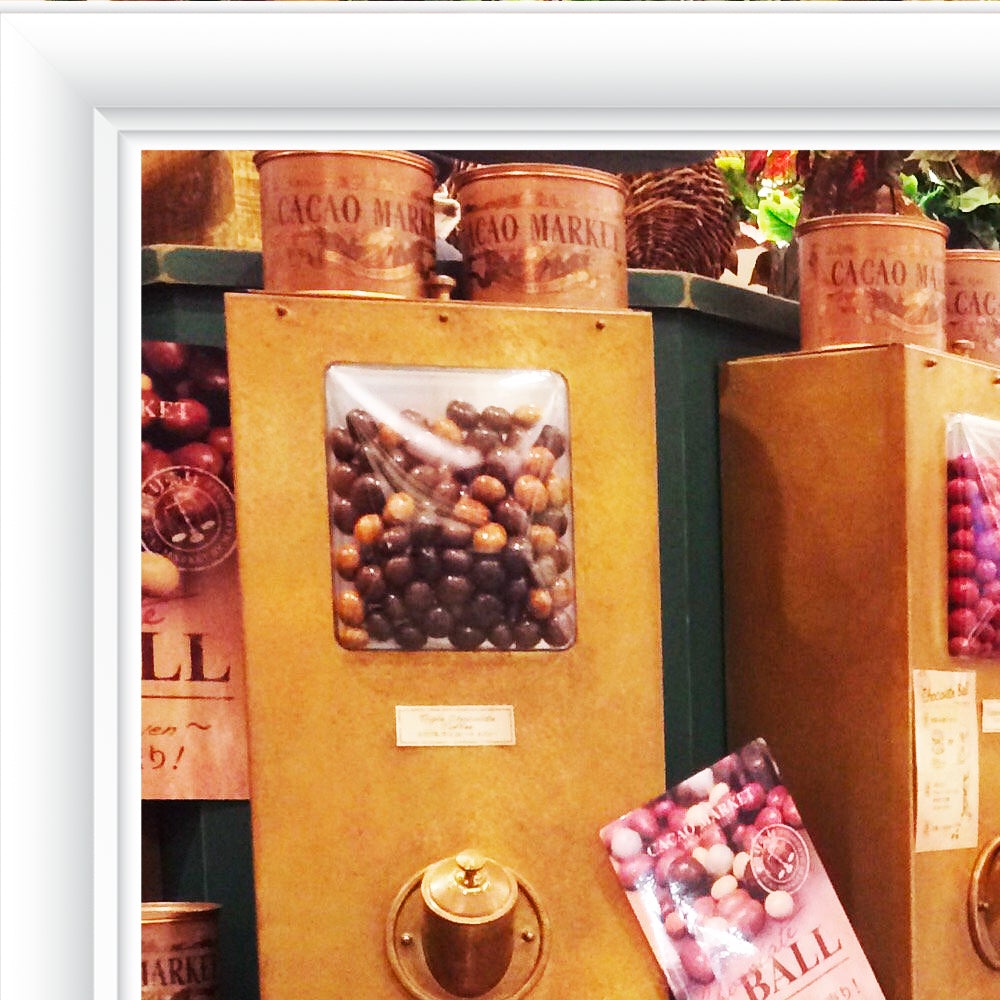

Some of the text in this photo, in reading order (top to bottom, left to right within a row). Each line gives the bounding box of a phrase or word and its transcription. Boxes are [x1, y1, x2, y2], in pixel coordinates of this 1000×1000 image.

[277, 194, 361, 226] CACAO
[831, 258, 907, 287] CACAO
[648, 822, 697, 858] CACAO
